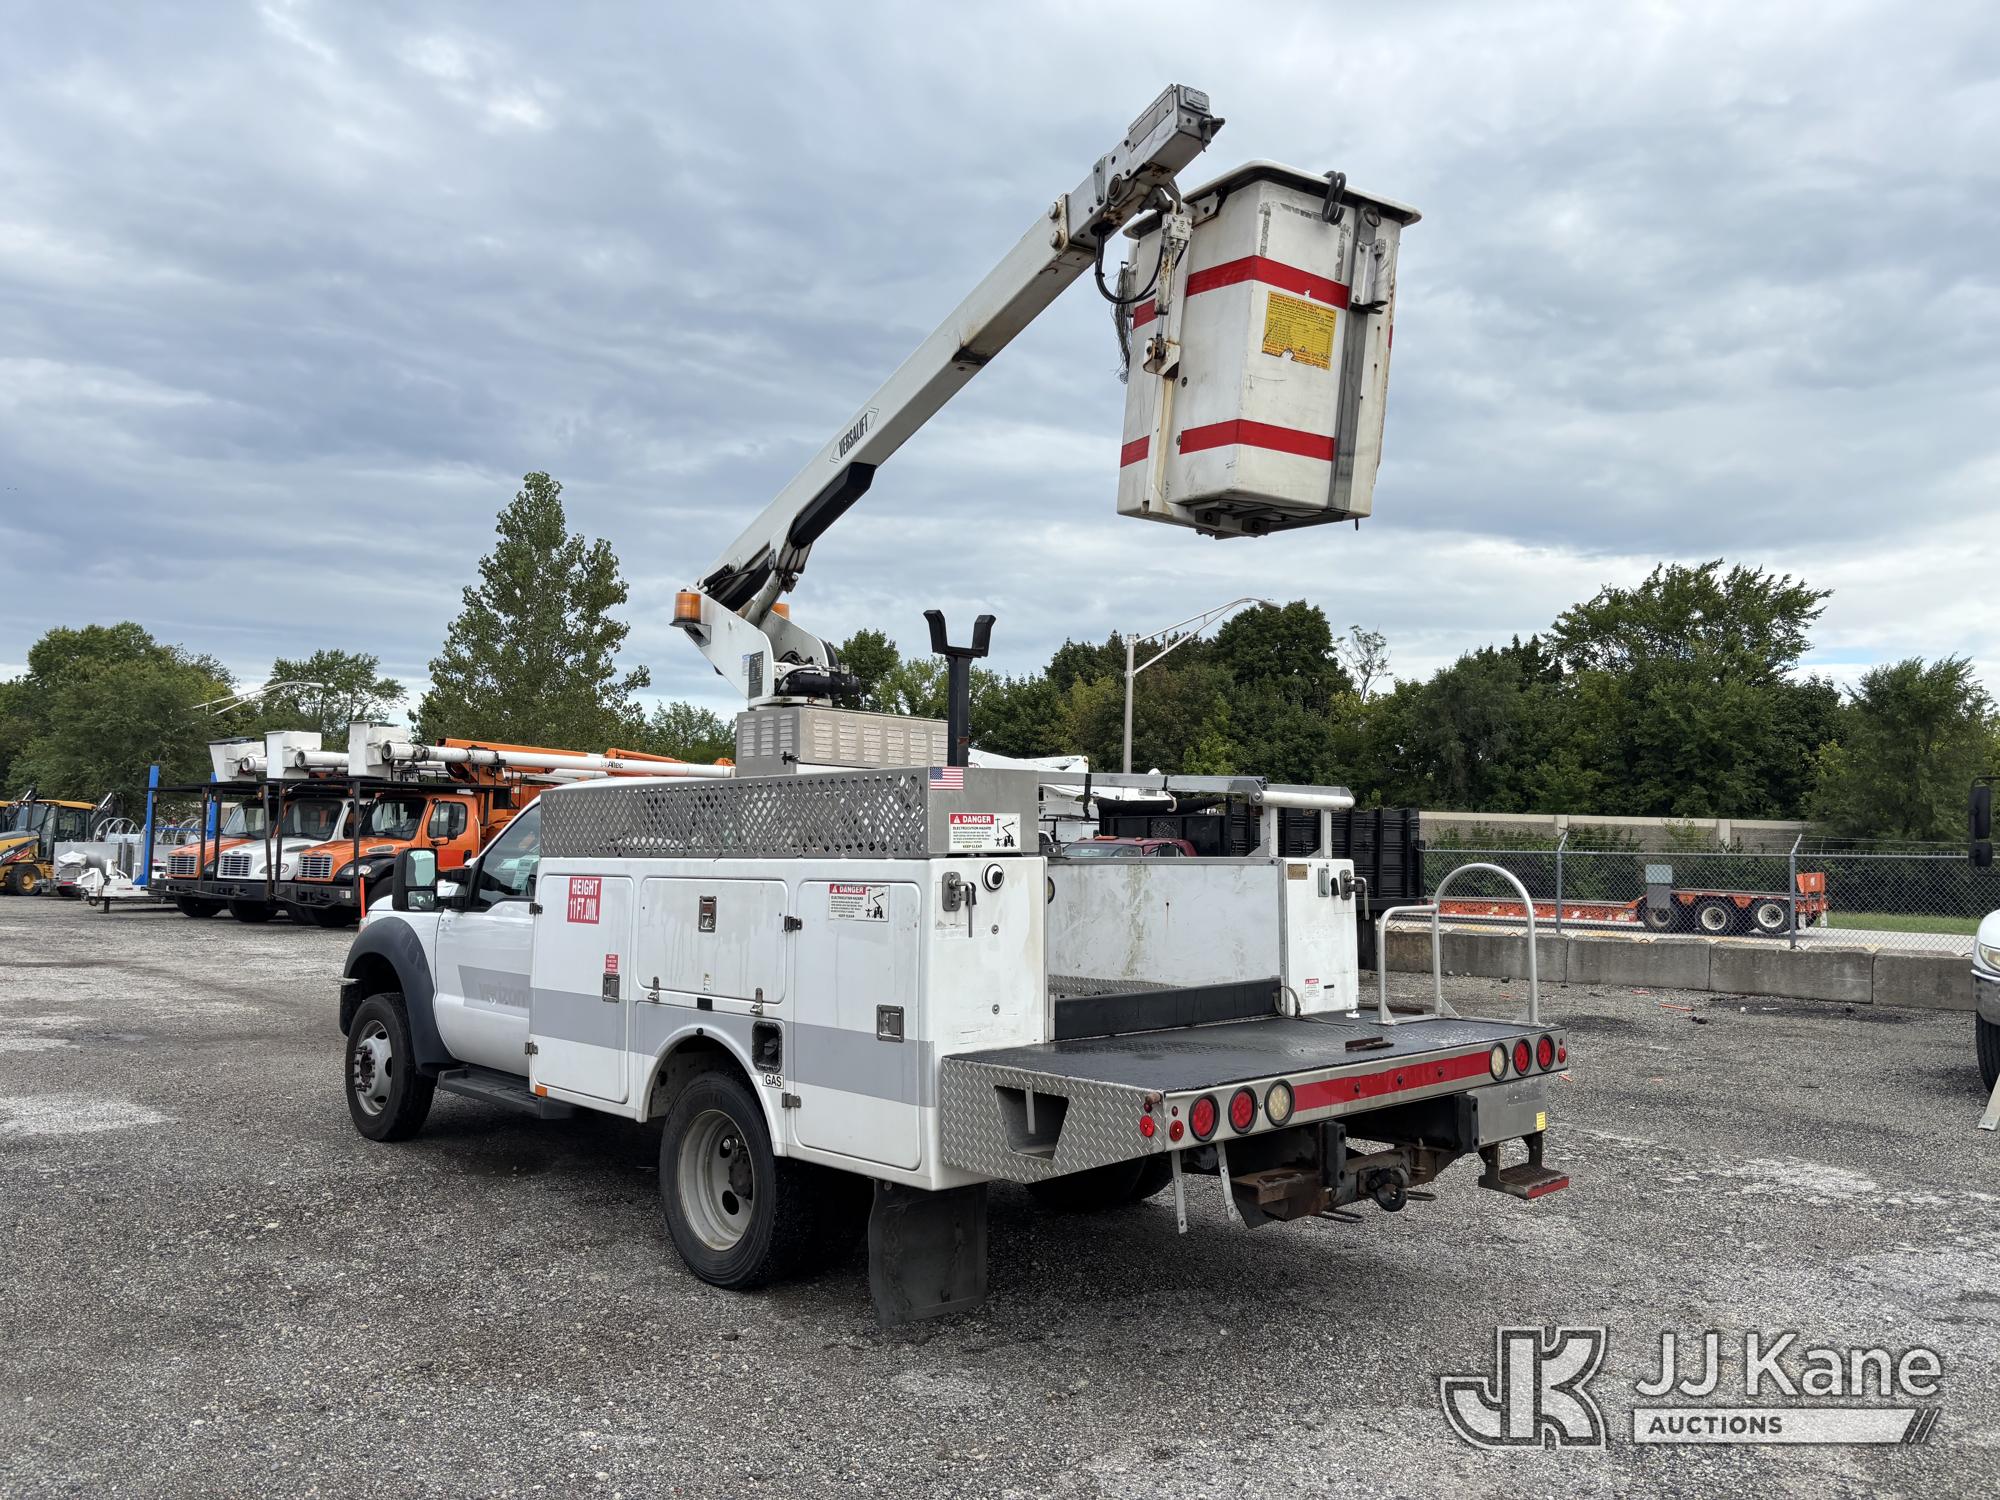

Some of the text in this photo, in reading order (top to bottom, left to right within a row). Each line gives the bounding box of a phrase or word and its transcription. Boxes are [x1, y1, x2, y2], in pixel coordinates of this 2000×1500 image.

[839, 412, 868, 458] VERSALIFT
[962, 815, 992, 824] DANGER
[572, 879, 599, 896] HEIGHT
[839, 885, 865, 894] DANGER
[765, 1074, 782, 1087] GAS
